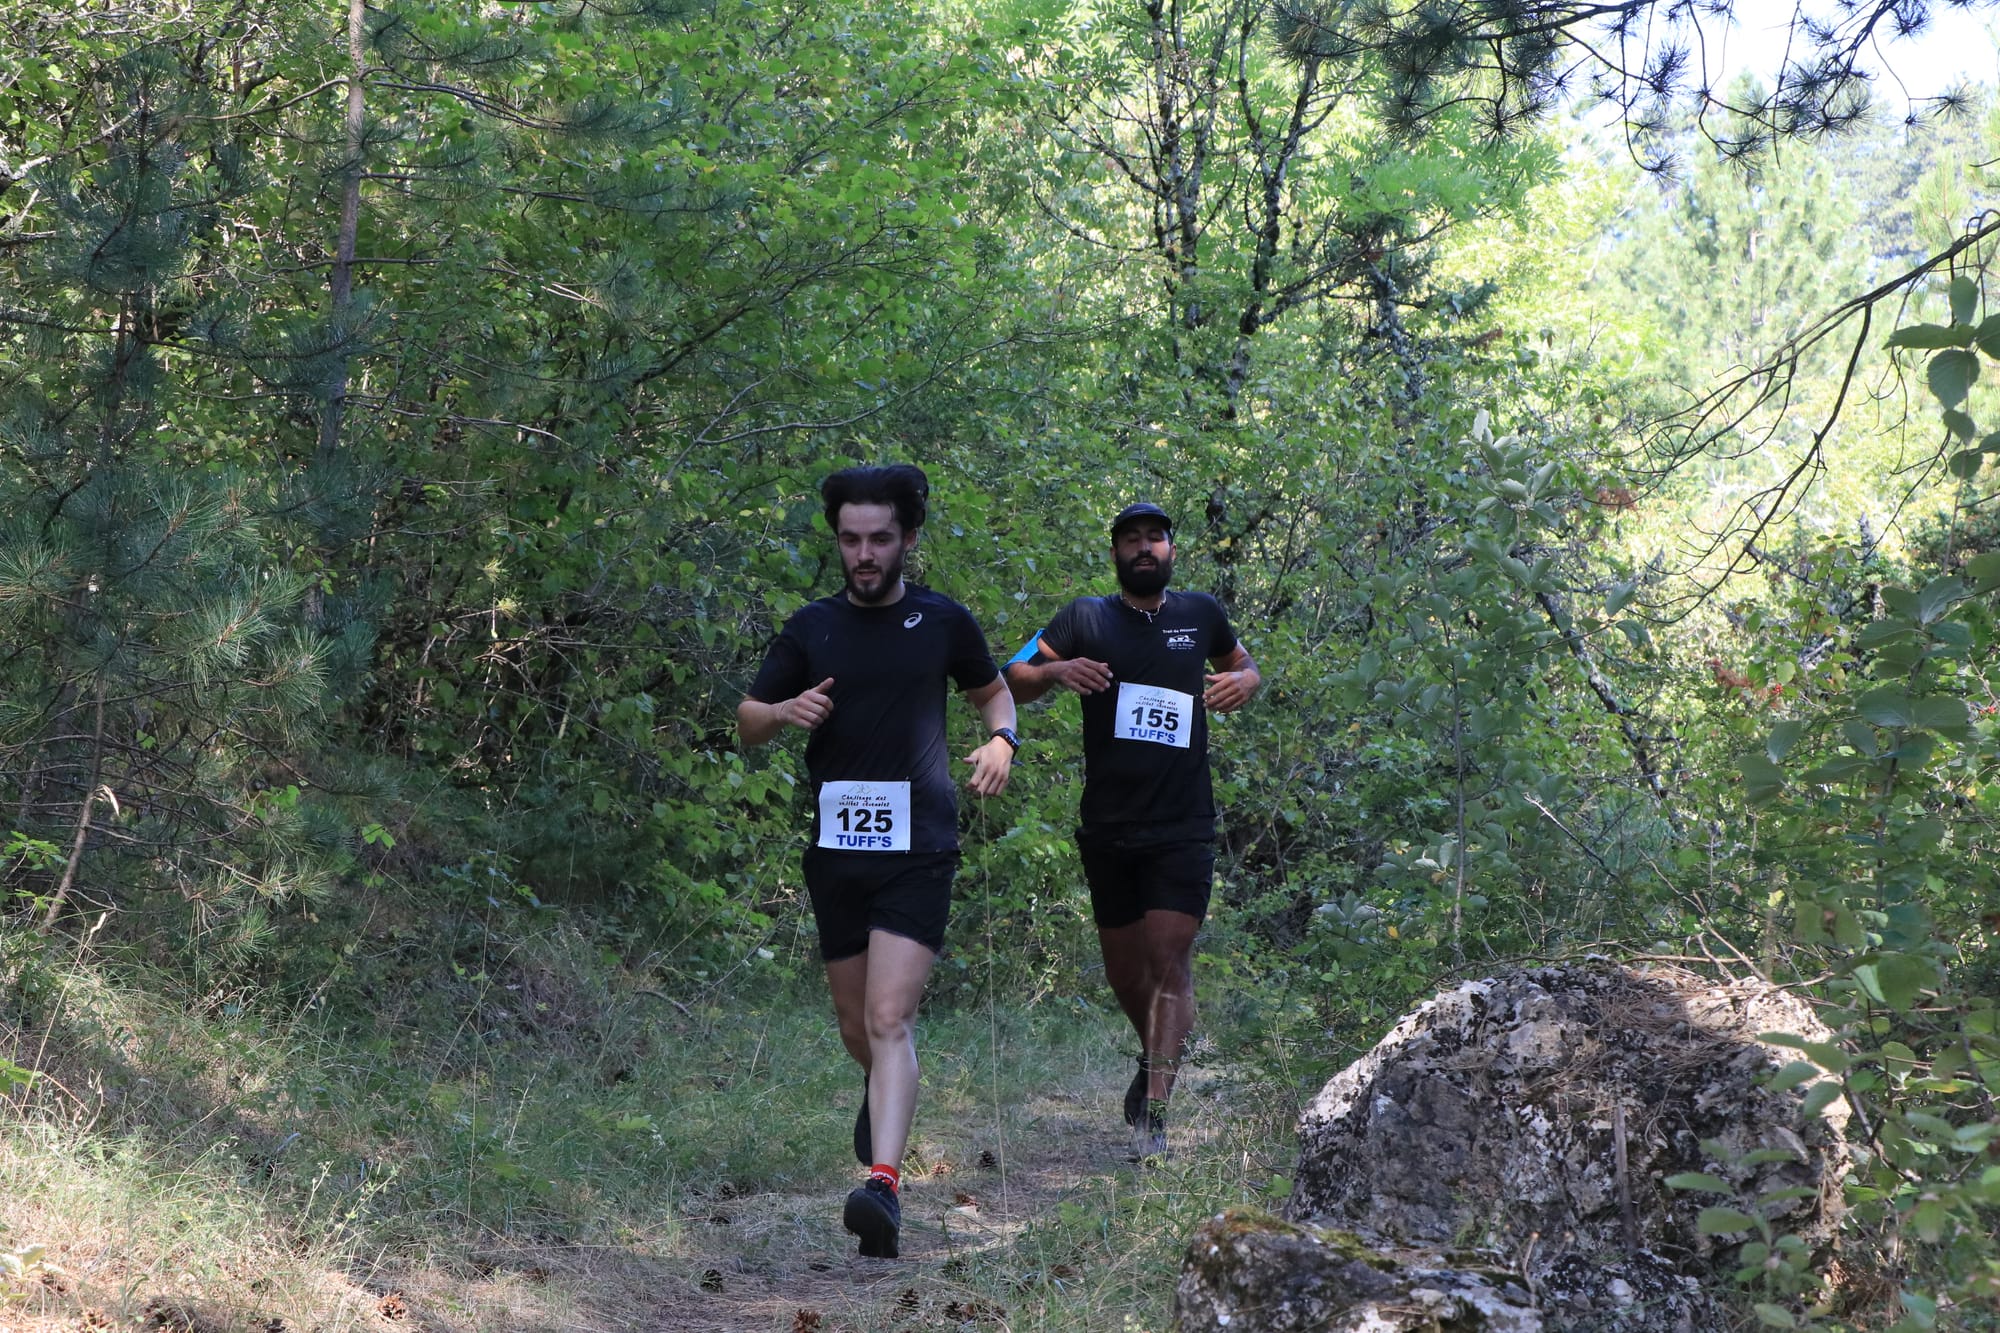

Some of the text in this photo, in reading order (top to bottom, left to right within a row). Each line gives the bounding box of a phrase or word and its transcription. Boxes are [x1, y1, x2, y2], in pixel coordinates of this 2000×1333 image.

[1131, 706, 1179, 731] 155
[1129, 727, 1176, 743] TUFF'S
[836, 807, 893, 833] 125
[836, 834, 892, 848] TUFF'S
